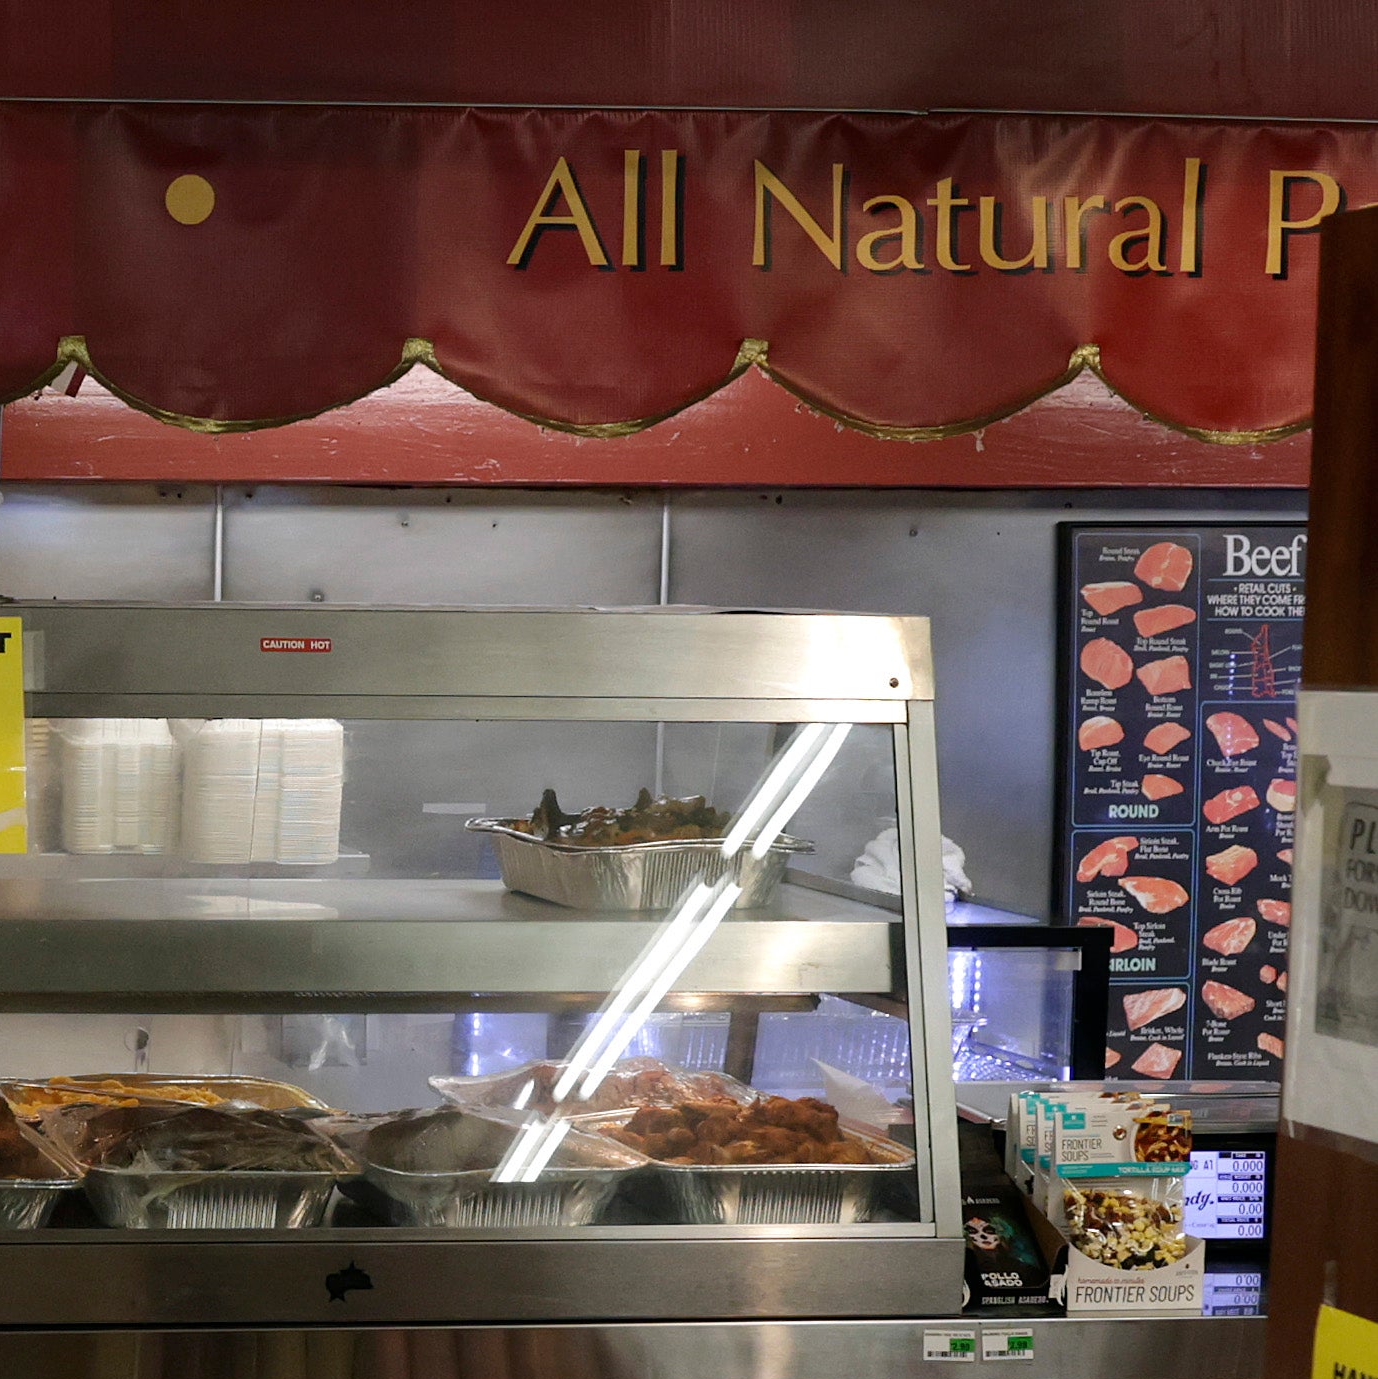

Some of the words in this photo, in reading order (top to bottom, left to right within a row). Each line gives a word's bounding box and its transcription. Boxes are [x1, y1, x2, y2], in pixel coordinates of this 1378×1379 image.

[505, 149, 683, 272] All
[752, 156, 1208, 277] Natural
[1222, 534, 1307, 577] Beef
[1238, 583, 1266, 594] RETAIL
[1267, 583, 1291, 594] CUTS
[1207, 595, 1241, 605] WHERE
[1242, 595, 1262, 605] THEY
[1263, 595, 1292, 605] COME
[1215, 606, 1236, 617] HOW
[1236, 606, 1252, 617] TO
[1254, 606, 1284, 617] COOK
[263, 640, 305, 649] CAUTION
[310, 641, 330, 650] HOT
[1109, 804, 1159, 819] ROUND
[1109, 957, 1157, 972] IRLOIN
[1061, 1138, 1102, 1150] FRONTIER
[1061, 1150, 1089, 1162] SOUPS
[1203, 1159, 1213, 1170] A1
[1232, 1160, 1263, 1172] 0.000
[1232, 1182, 1263, 1193] 0.000
[1238, 1203, 1262, 1215] 0.00
[1237, 1224, 1262, 1236] 0.00
[981, 1272, 1020, 1281] POLLO
[1077, 1276, 1111, 1285] homemade
[984, 1279, 1023, 1287] ASADO
[1076, 1286, 1146, 1304] FRONTIER
[1148, 1284, 1195, 1302] SOUPS
